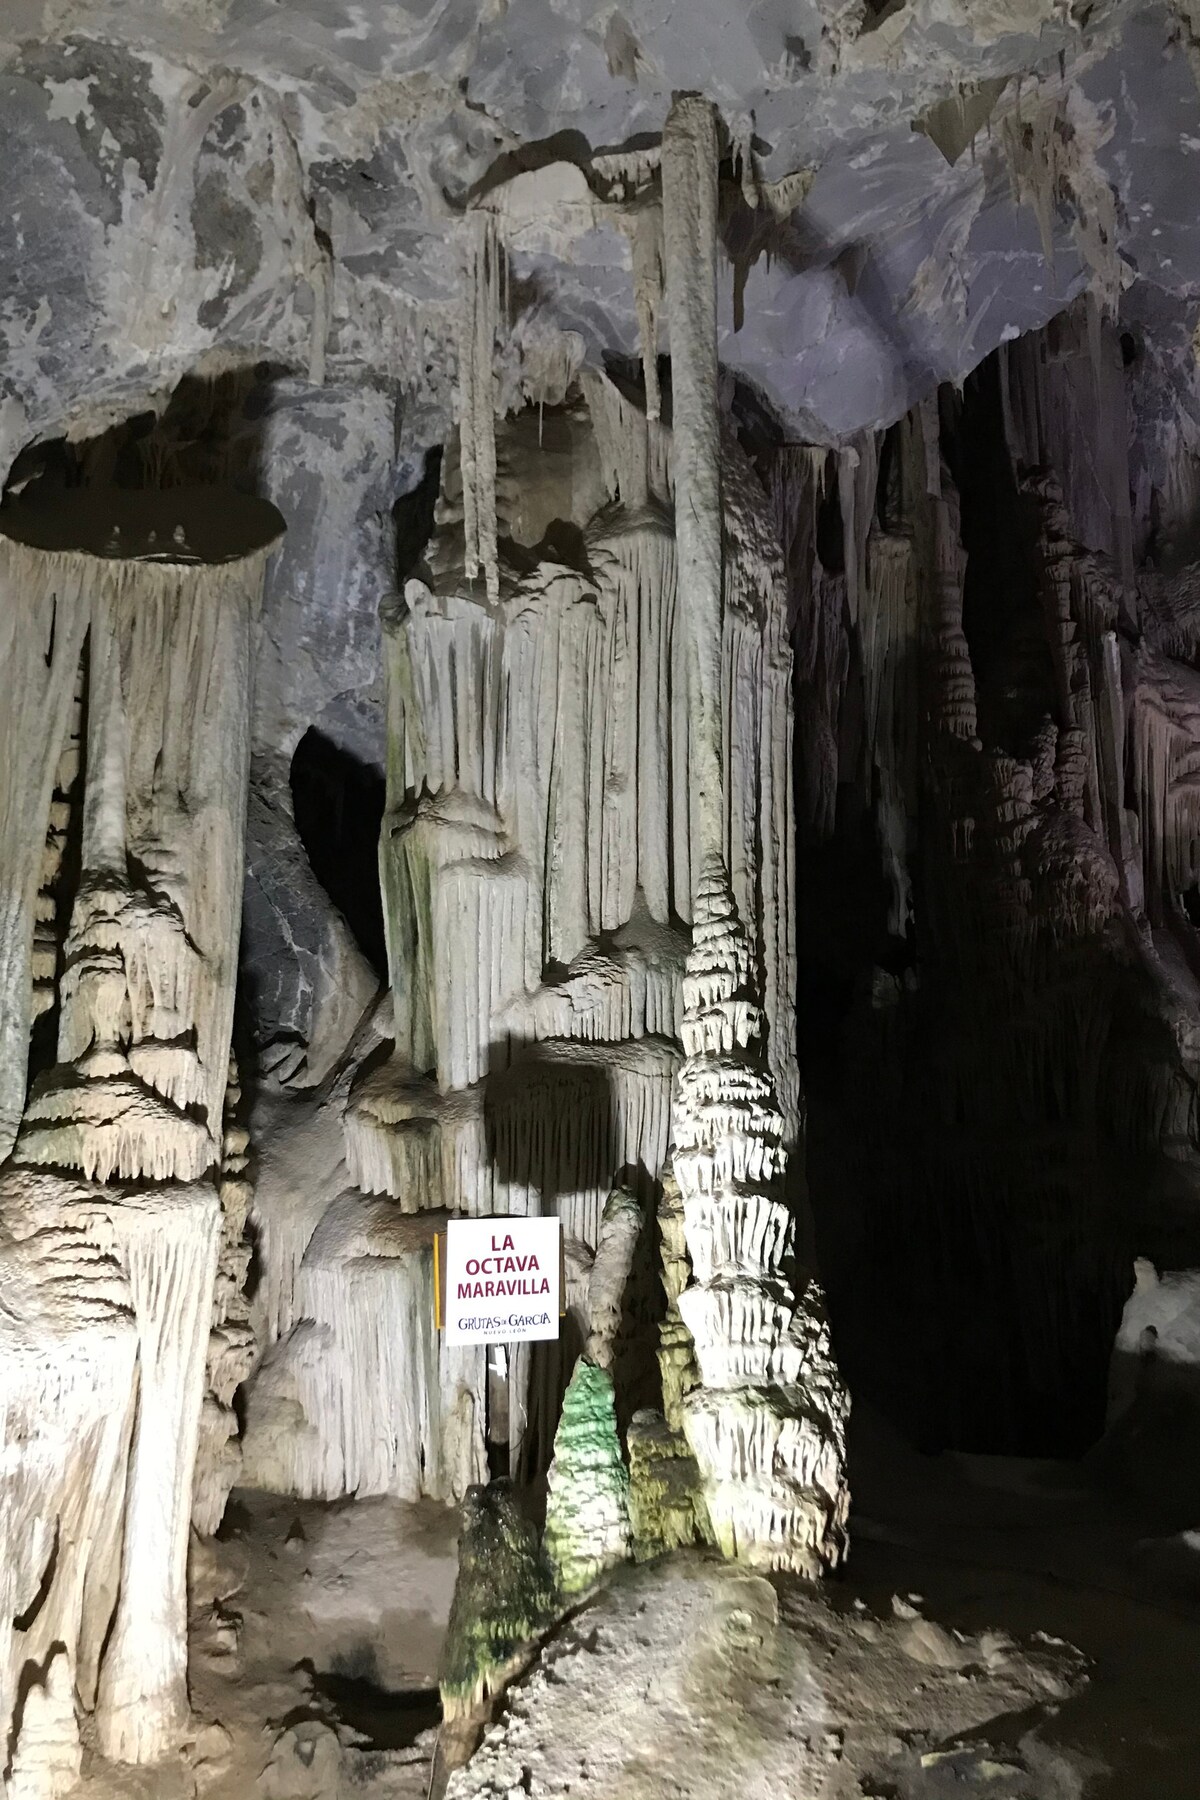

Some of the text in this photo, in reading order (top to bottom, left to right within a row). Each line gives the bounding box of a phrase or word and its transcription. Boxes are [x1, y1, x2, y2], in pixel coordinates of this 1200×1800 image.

[491, 1234, 515, 1251] LA
[465, 1255, 540, 1276] OCTAVA
[457, 1278, 550, 1299] MARAVILLA
[458, 1316, 501, 1330] GRUTAS
